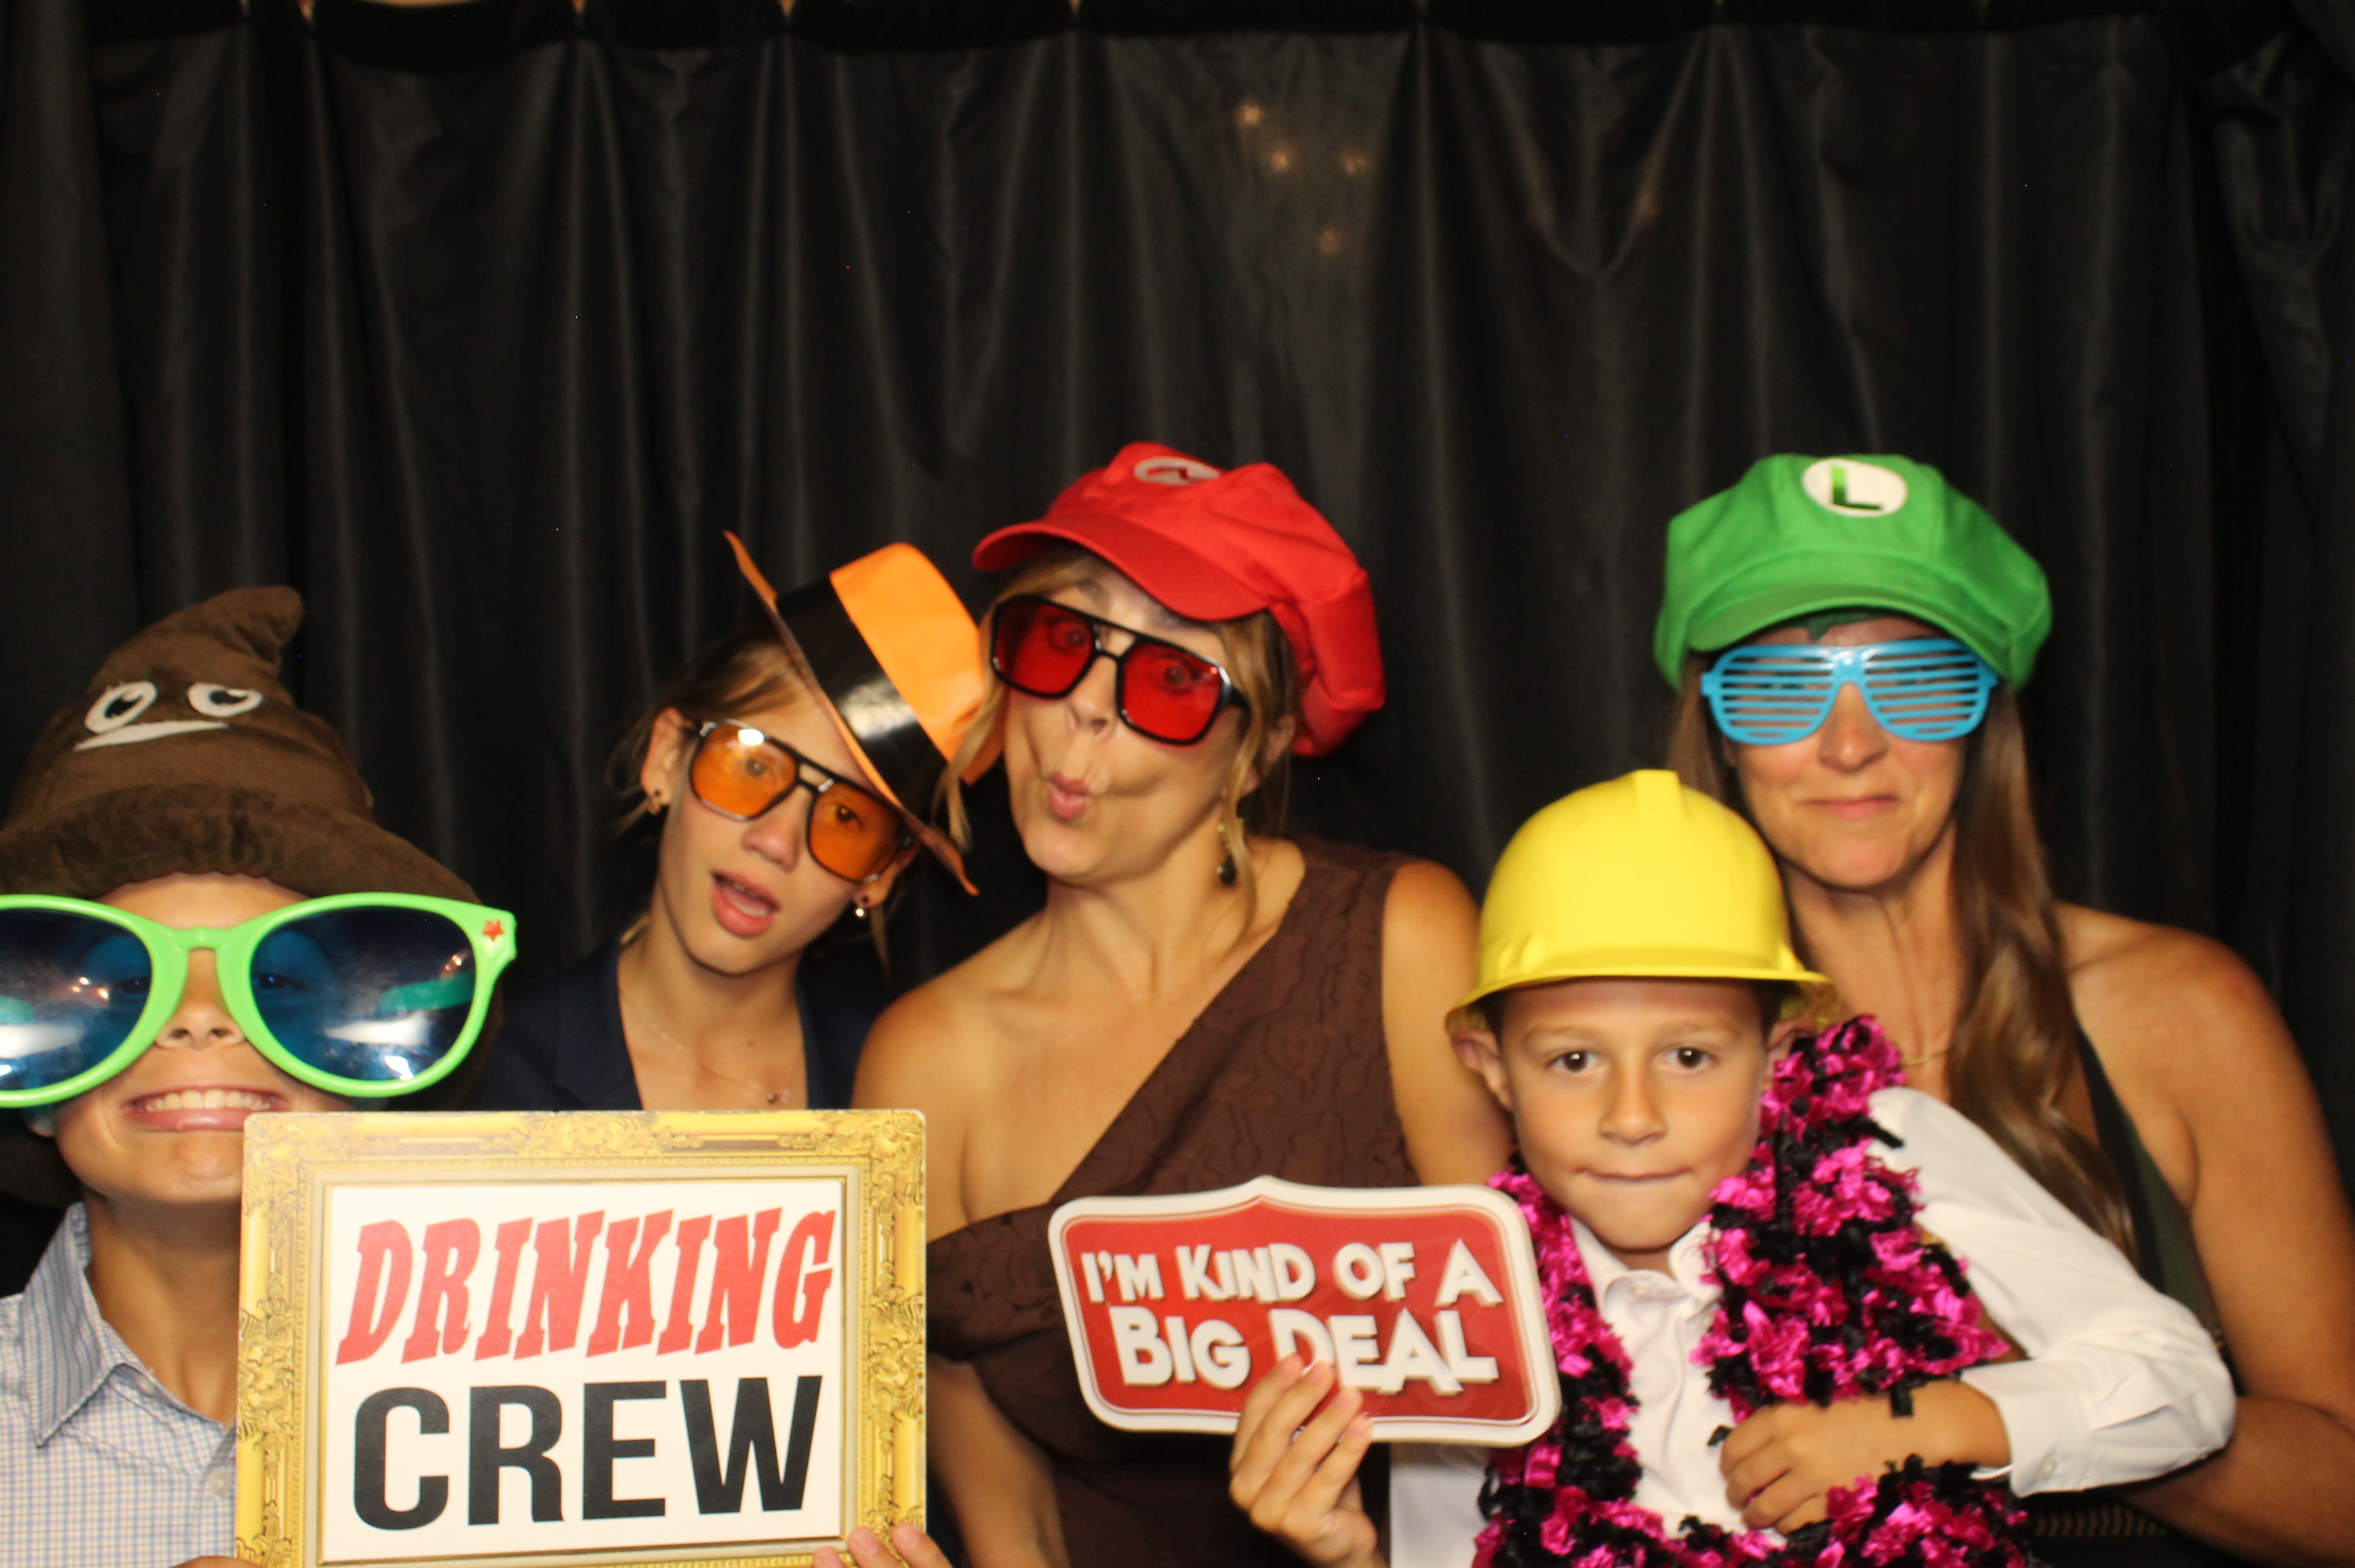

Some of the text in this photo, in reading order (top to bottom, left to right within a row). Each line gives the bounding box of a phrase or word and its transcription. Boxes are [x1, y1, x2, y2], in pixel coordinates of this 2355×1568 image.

[1831, 464, 1881, 510] L
[336, 1207, 836, 1365] DRINKING
[1081, 1239, 1504, 1306] I'M KIND OF A
[1109, 1306, 1500, 1397] BIG DEAL
[353, 1375, 823, 1531] CREW
